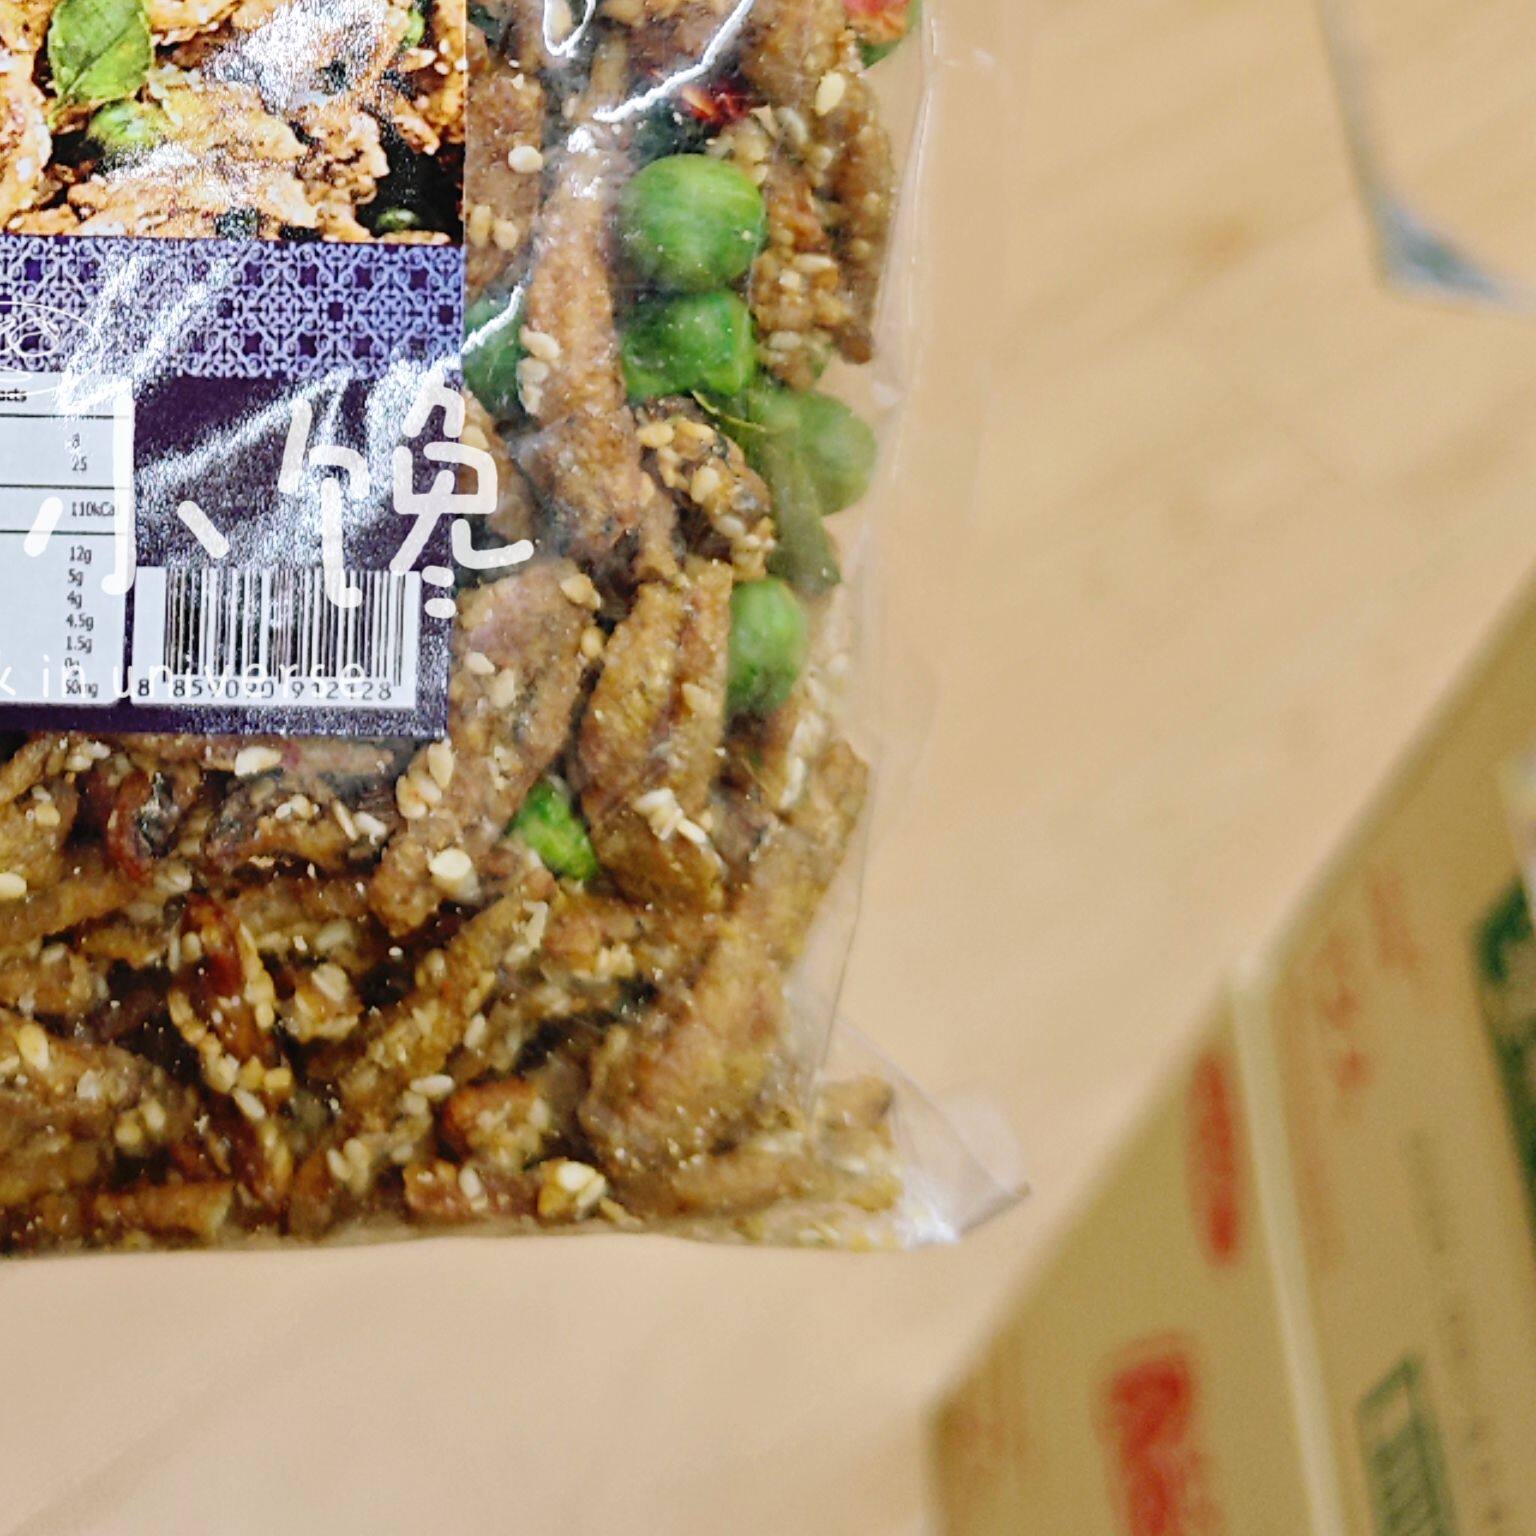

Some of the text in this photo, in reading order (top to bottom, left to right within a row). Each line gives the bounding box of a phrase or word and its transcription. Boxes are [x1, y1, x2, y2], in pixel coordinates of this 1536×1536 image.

[72, 501, 119, 517] 110kCa
[70, 545, 92, 564] 12g
[67, 568, 84, 586] 5g
[67, 590, 82, 609] 4g
[66, 613, 94, 631] 4.5g
[66, 636, 92, 654] 1.5g
[138, 679, 149, 696] 8
